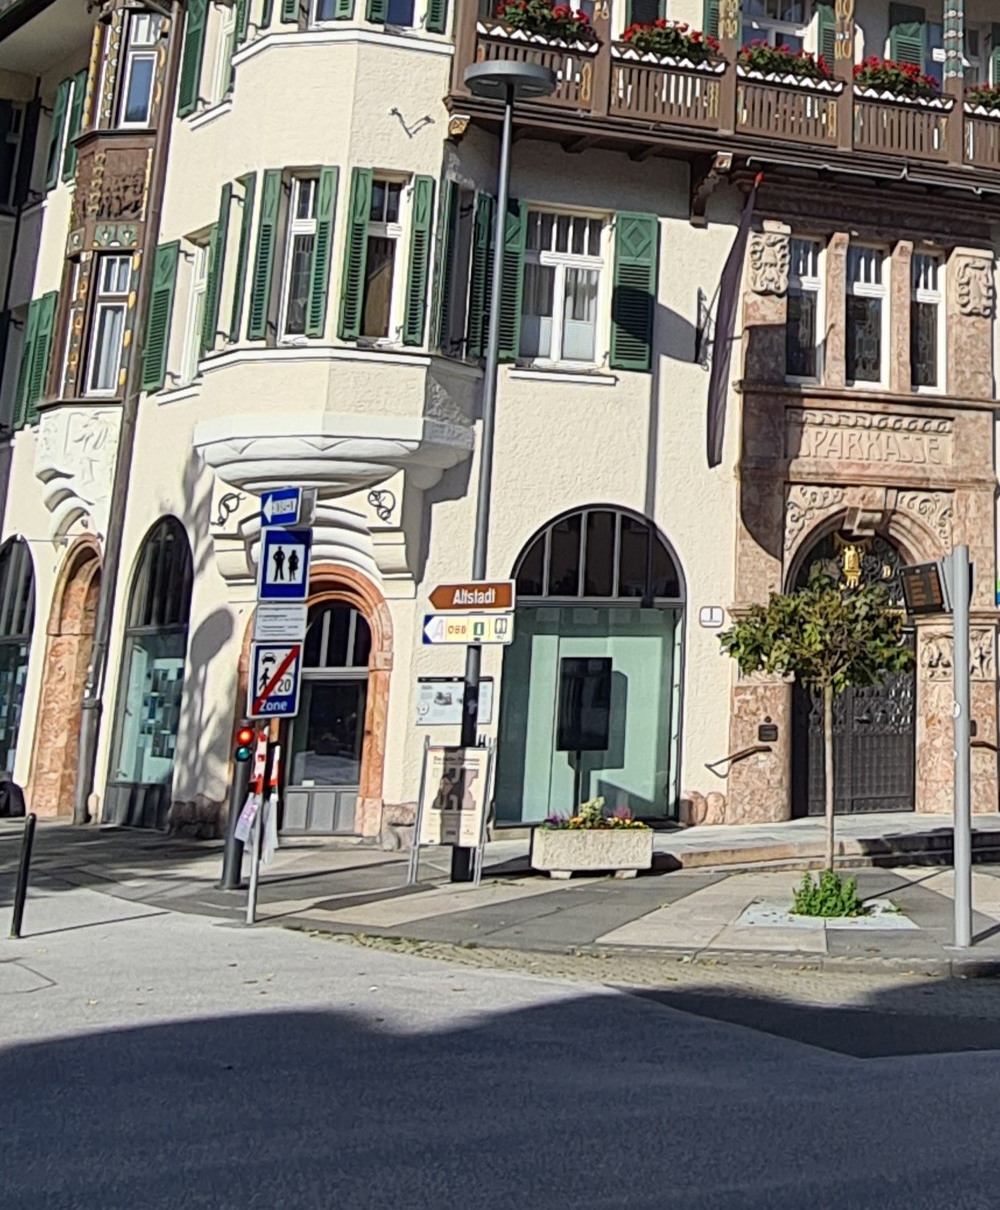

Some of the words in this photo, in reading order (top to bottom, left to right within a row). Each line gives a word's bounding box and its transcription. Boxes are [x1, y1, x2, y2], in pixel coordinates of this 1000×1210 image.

[799, 429, 940, 465] SPARKASSE
[453, 588, 496, 605] Altstadt
[278, 679, 291, 693] 20
[260, 699, 287, 712] Zone
